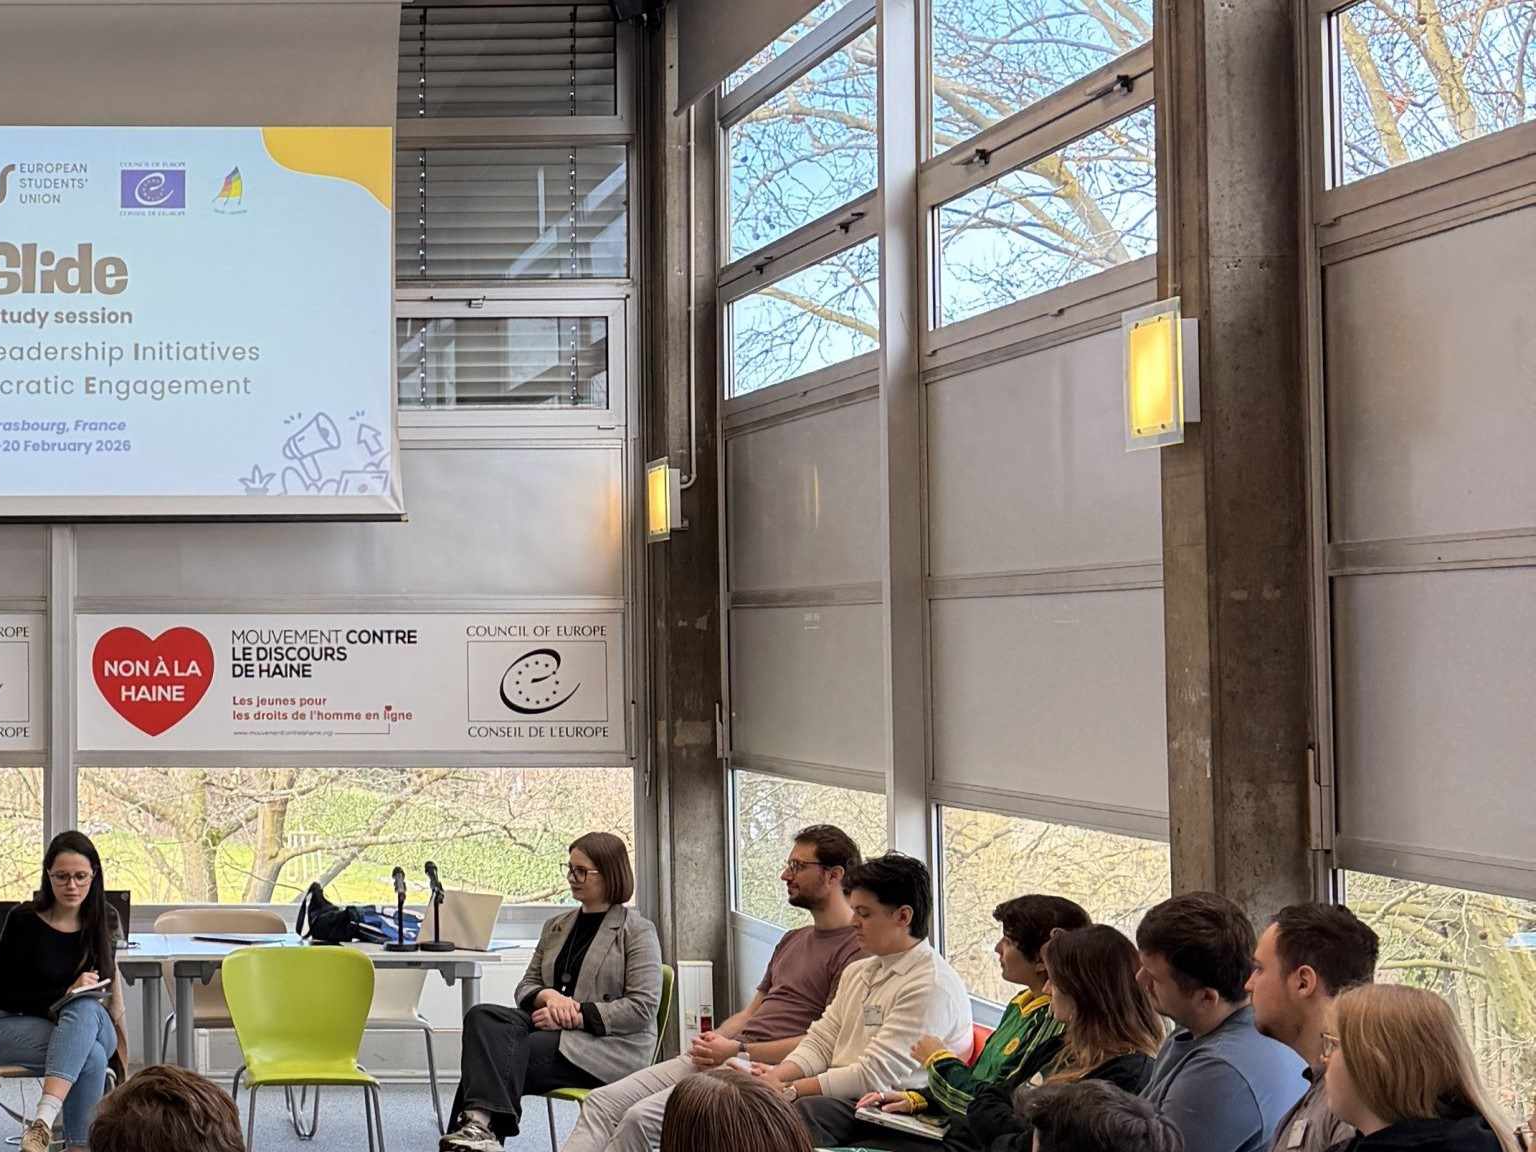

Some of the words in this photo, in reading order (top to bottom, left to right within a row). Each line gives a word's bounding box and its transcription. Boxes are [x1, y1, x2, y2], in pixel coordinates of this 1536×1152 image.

[19, 163, 88, 174] EUROPEAN
[19, 193, 62, 204] UNION
[54, 307, 133, 325] session
[133, 341, 261, 362] Initiatives
[84, 376, 252, 400] Engagement
[74, 418, 126, 432] France
[23, 439, 92, 456] February
[95, 439, 131, 453] 2026
[232, 629, 342, 645] MOUVEMENT
[346, 629, 418, 645] CONTRE
[466, 625, 527, 637] COUNCIL
[533, 625, 551, 637] OF
[556, 625, 607, 637] EUROPE
[232, 646, 254, 661] LE
[256, 646, 348, 661] DISCOURS
[103, 659, 153, 678] NON
[154, 656, 170, 678] À
[174, 659, 202, 678] LA
[232, 663, 254, 678] DE
[260, 663, 312, 678] HAINE
[120, 684, 185, 702] HAINE
[232, 696, 254, 706] Les
[256, 696, 296, 708] jeunes
[299, 697, 327, 708] pour
[232, 710, 250, 721] les
[253, 710, 288, 721] droits
[292, 710, 306, 721] de
[310, 710, 361, 721] l'homme
[365, 711, 380, 721] en
[384, 708, 413, 722] ligne
[468, 726, 525, 738] CONSEIL
[529, 726, 546, 738] DE
[549, 726, 608, 738] L'EUROPE
